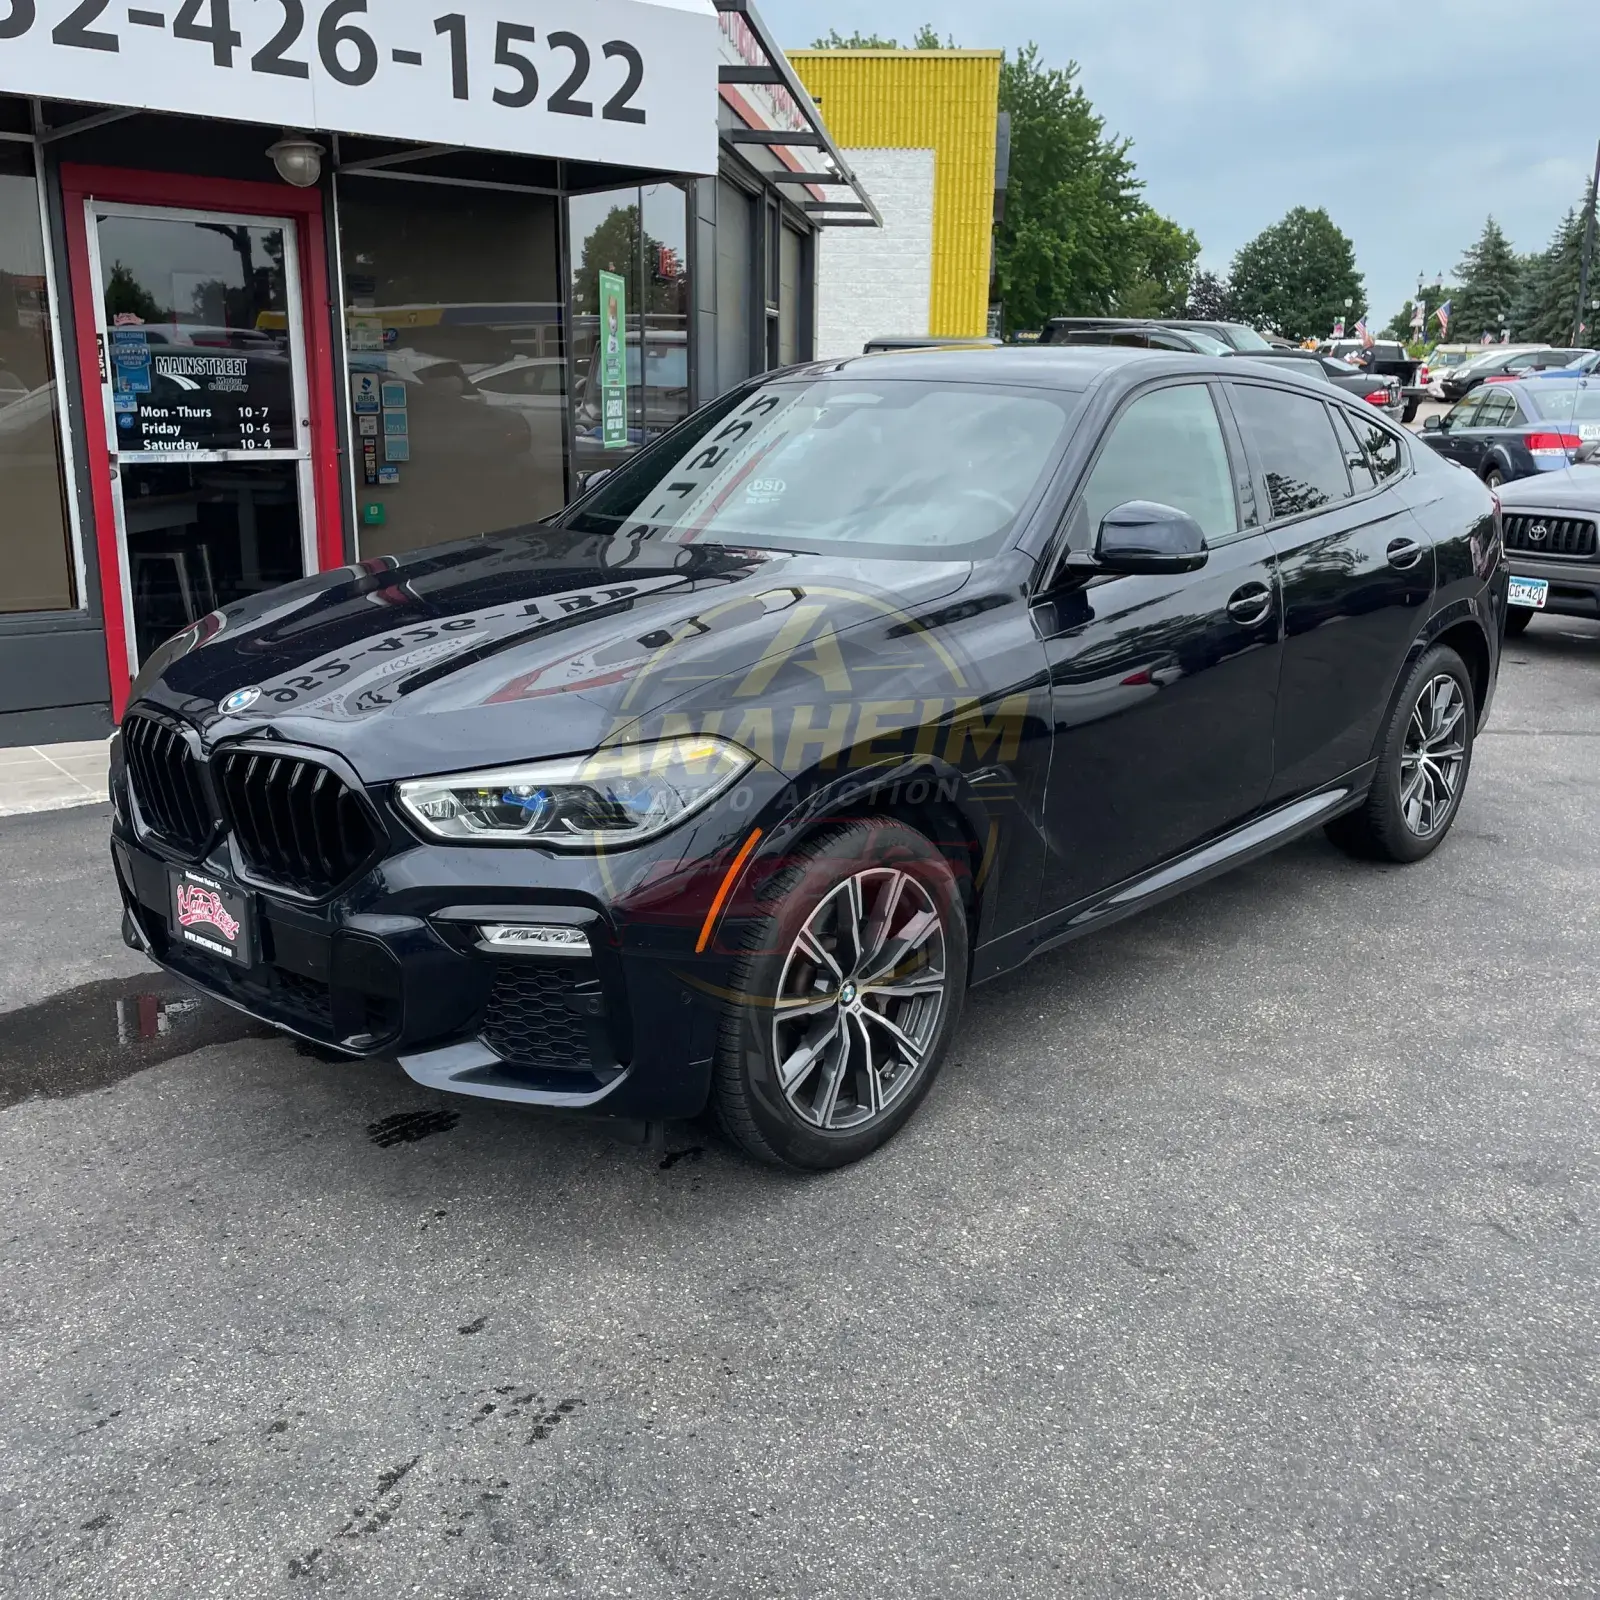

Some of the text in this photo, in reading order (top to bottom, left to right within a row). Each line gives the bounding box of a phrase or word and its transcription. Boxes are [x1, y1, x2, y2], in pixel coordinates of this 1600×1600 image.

[155, 356, 248, 376] MAINSTREET
[216, 376, 243, 385] Motor
[208, 383, 249, 393] Company
[357, 394, 376, 402] BBB
[140, 406, 169, 418] Mon
[142, 422, 181, 437] Friday
[143, 439, 199, 450] Saturday
